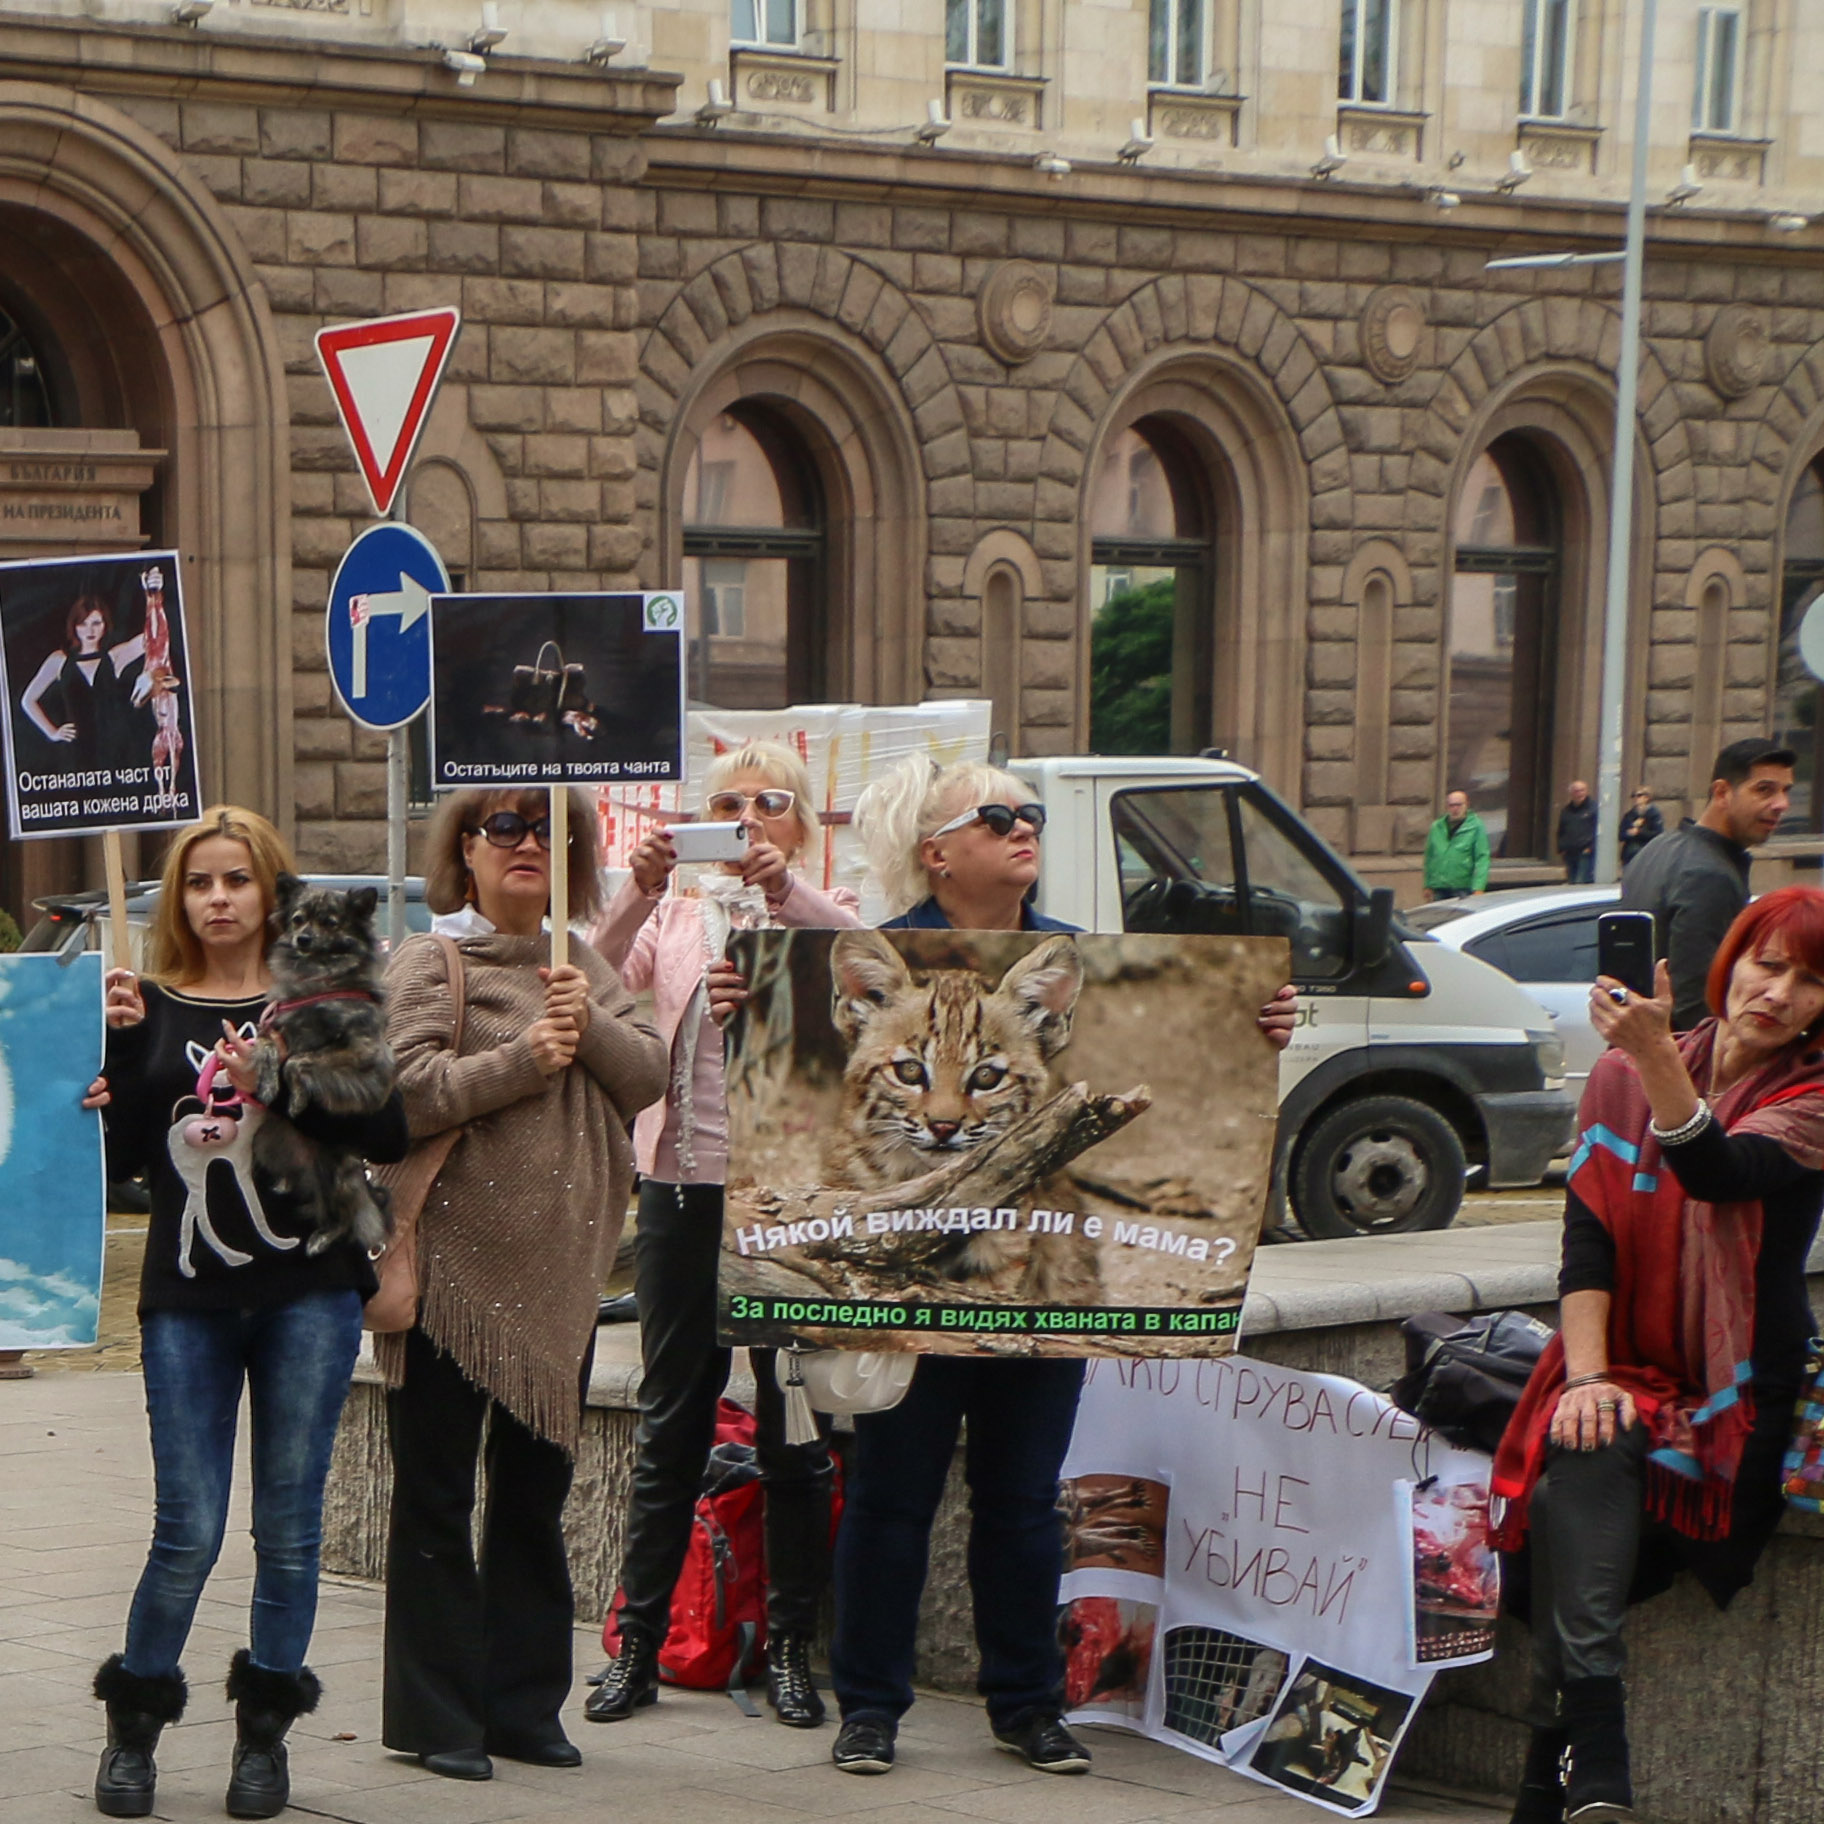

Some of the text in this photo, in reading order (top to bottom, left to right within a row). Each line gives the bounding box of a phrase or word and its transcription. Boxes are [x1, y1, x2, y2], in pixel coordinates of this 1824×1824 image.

[10, 465, 96, 482] БЪЛГАРИЯ
[3, 503, 25, 519] НА
[28, 504, 122, 522] ПРЕЗИДЕНТА
[19, 765, 171, 792] Останалата част от
[443, 760, 671, 779] Остатъците на твоята чанта
[21, 791, 189, 820] вашата кожена дреха
[736, 1207, 1237, 1266] Някой виждал ли е мама?
[730, 1295, 764, 1319] За
[773, 1302, 907, 1327] последно
[914, 1307, 931, 1326] я
[940, 1308, 1028, 1331] видях
[1034, 1310, 1136, 1331] хваната
[1145, 1312, 1161, 1330] в
